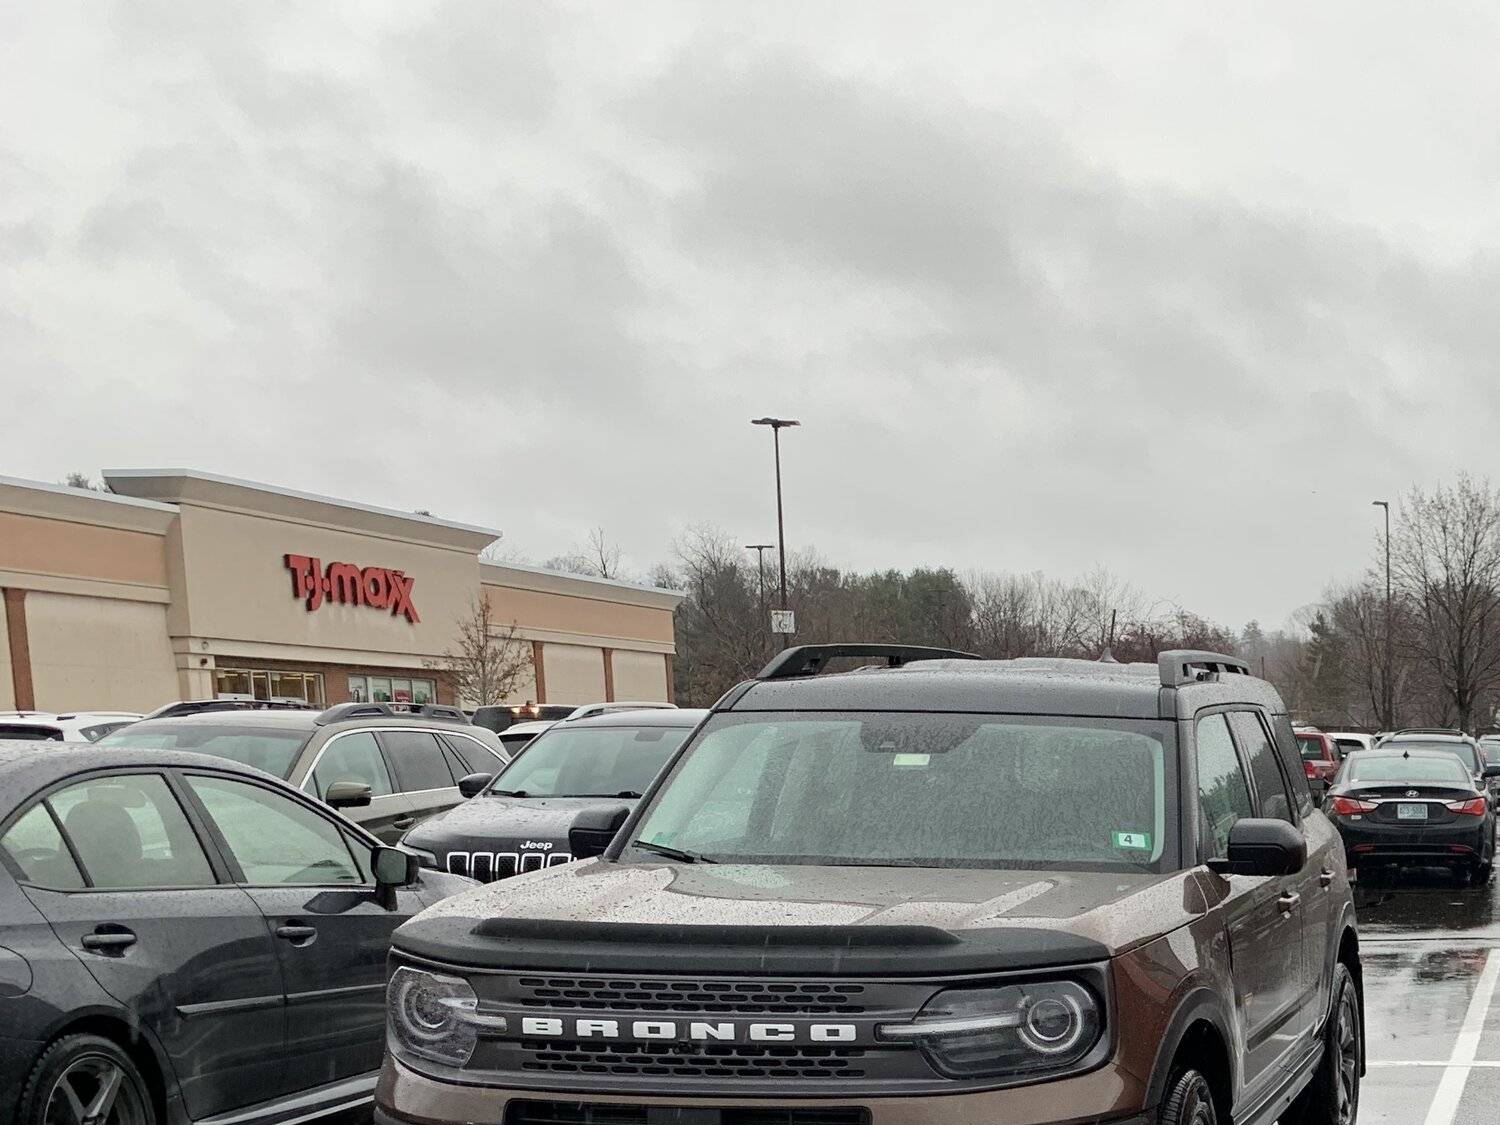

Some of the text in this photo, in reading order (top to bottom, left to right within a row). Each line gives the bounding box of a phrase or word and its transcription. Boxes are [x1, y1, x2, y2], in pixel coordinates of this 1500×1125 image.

[1124, 834, 1133, 844] 4
[520, 840, 553, 851] Jeep
[522, 1017, 857, 1042] BRONCO
